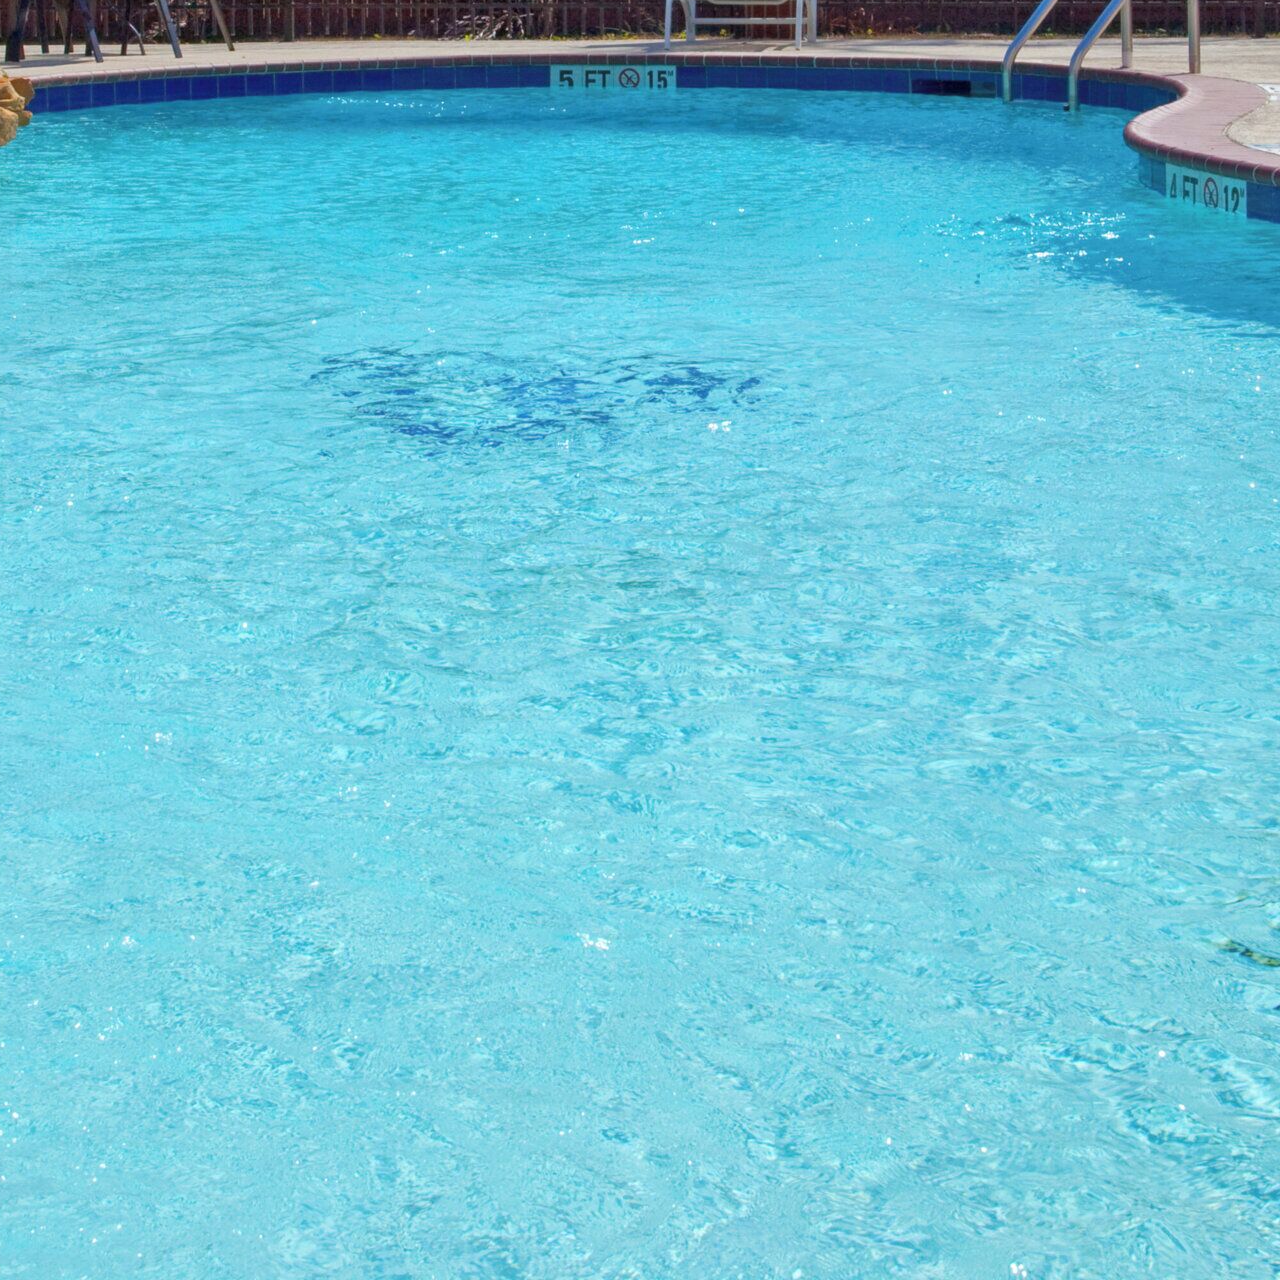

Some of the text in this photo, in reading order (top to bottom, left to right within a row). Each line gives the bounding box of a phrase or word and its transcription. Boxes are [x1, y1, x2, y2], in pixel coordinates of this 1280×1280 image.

[559, 69, 575, 88] 5
[584, 69, 611, 88] FT
[1182, 174, 1199, 205] FT
